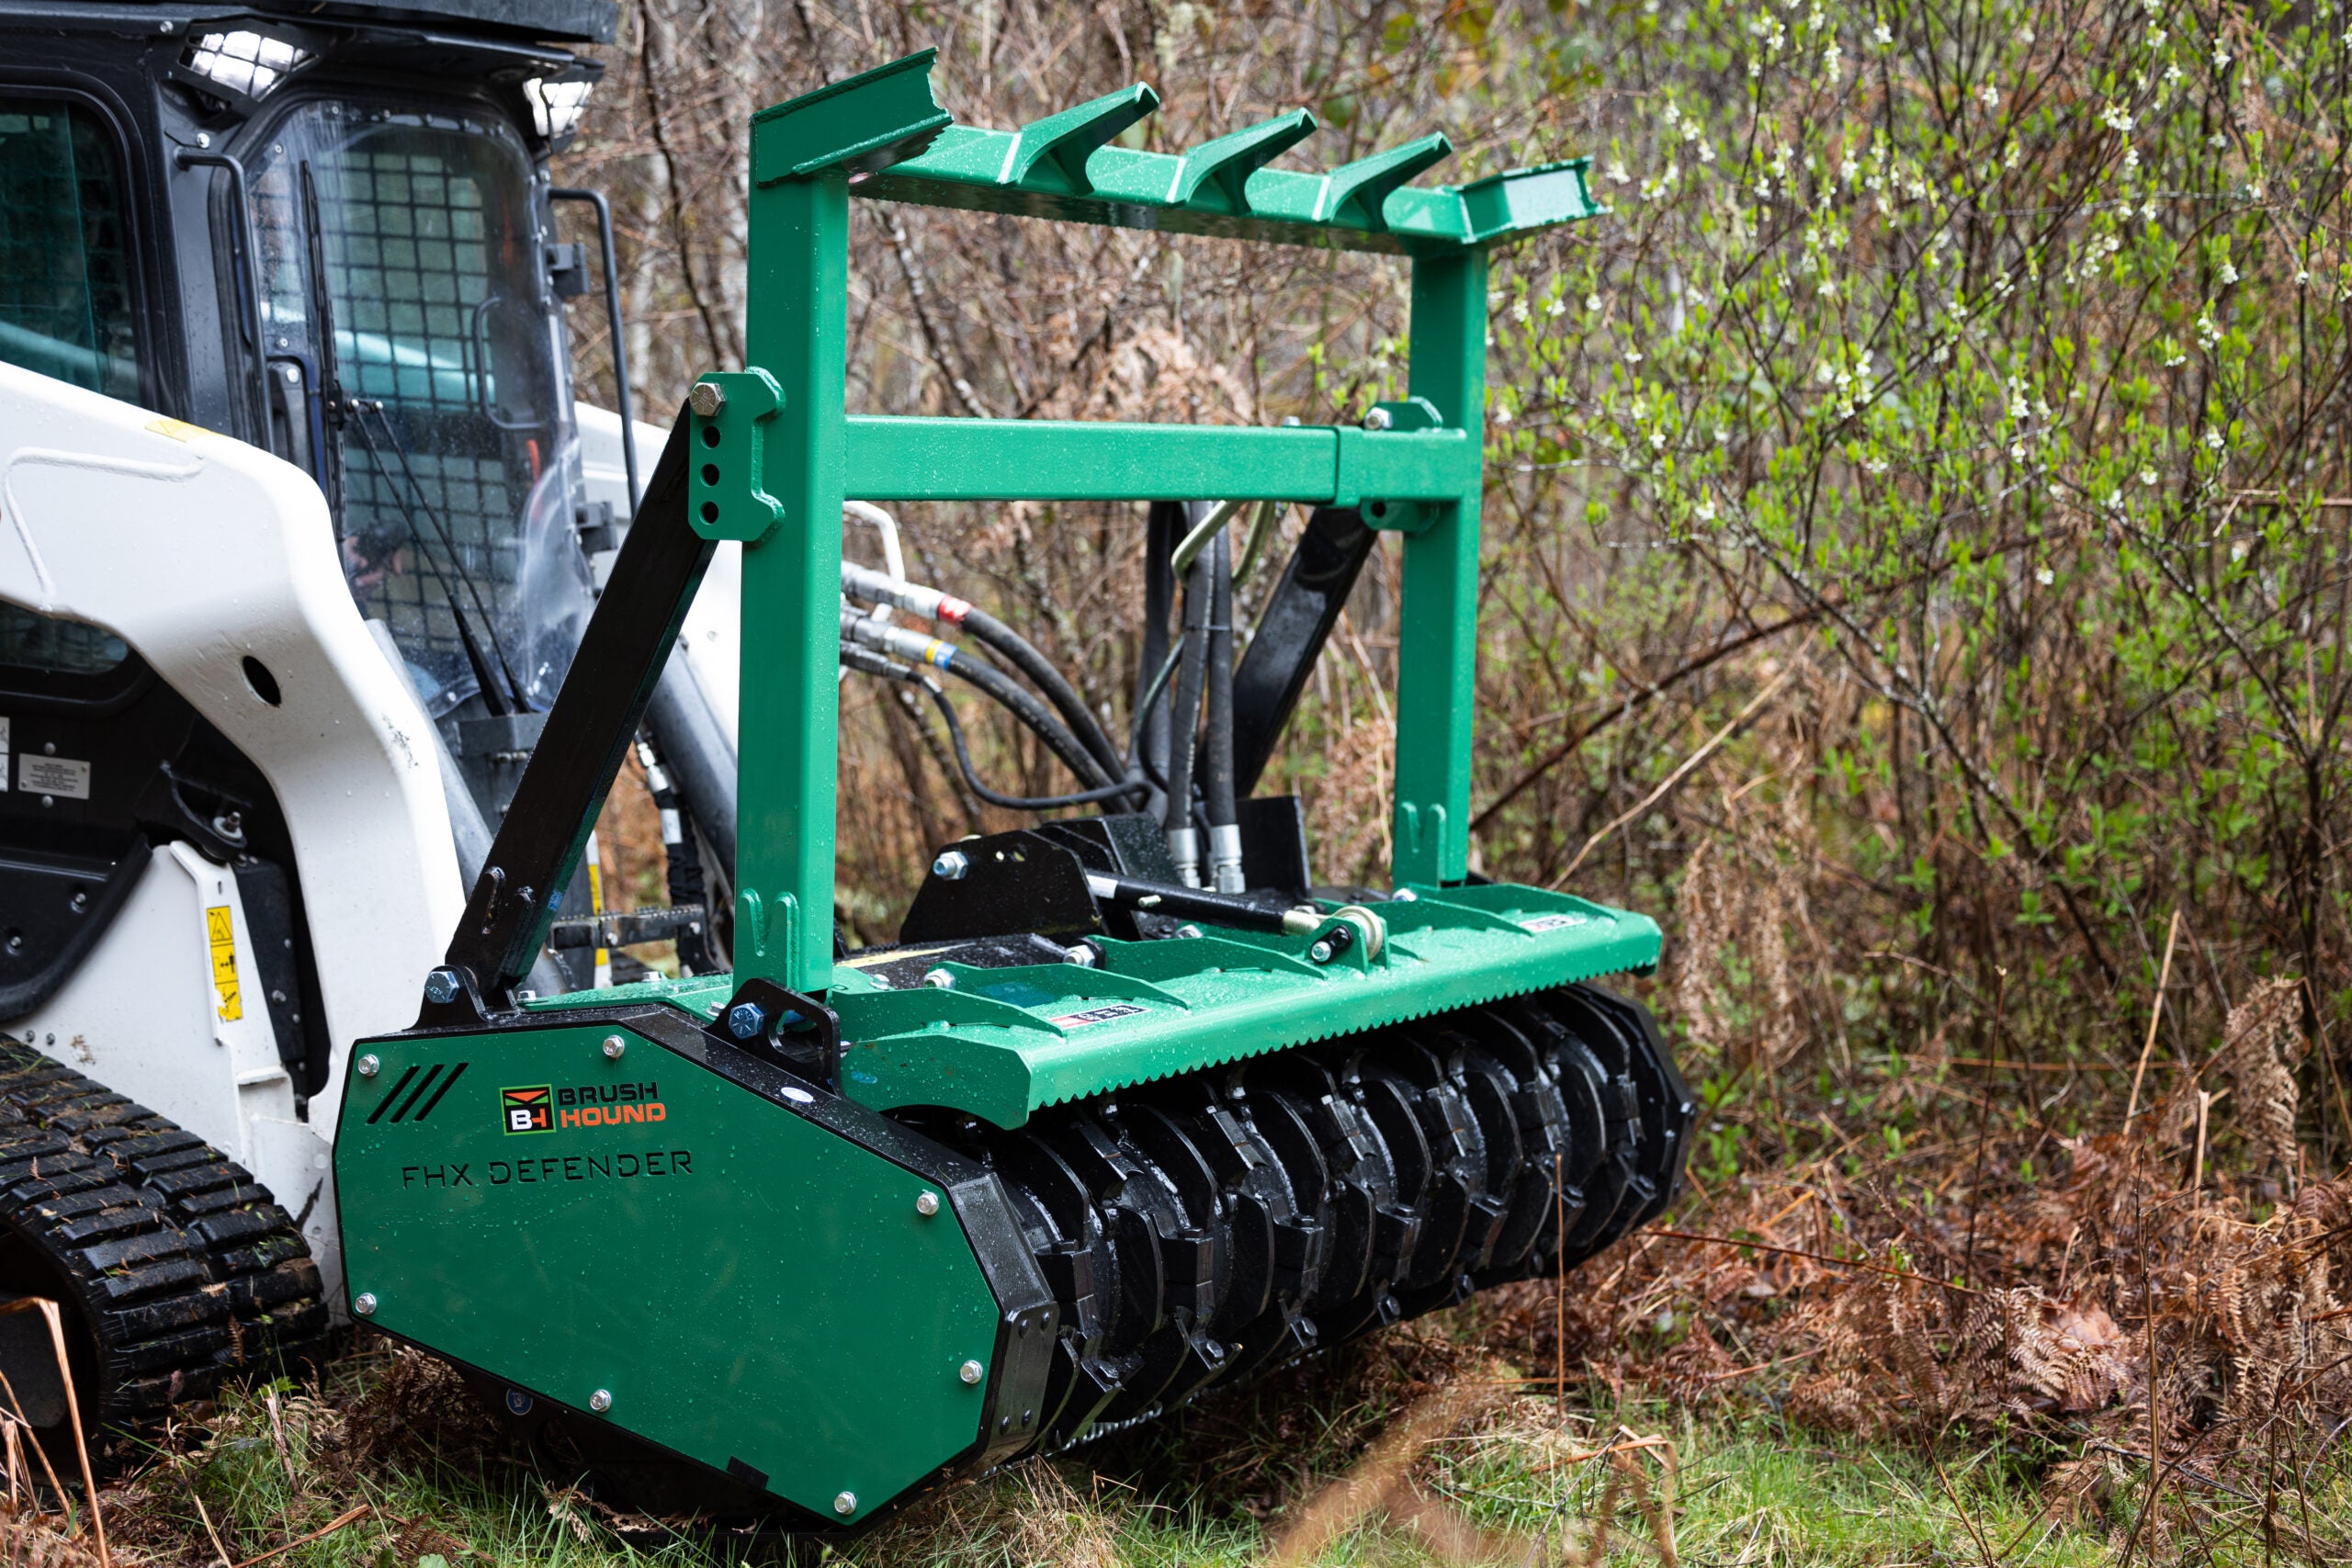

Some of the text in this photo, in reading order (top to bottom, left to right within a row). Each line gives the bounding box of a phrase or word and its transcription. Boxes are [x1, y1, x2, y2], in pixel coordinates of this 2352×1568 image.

[558, 1081, 659, 1106] BRUSH
[510, 1107, 548, 1131] BH
[560, 1102, 666, 1129] HOUND
[401, 1150, 693, 1190] FHX DEFENDER
